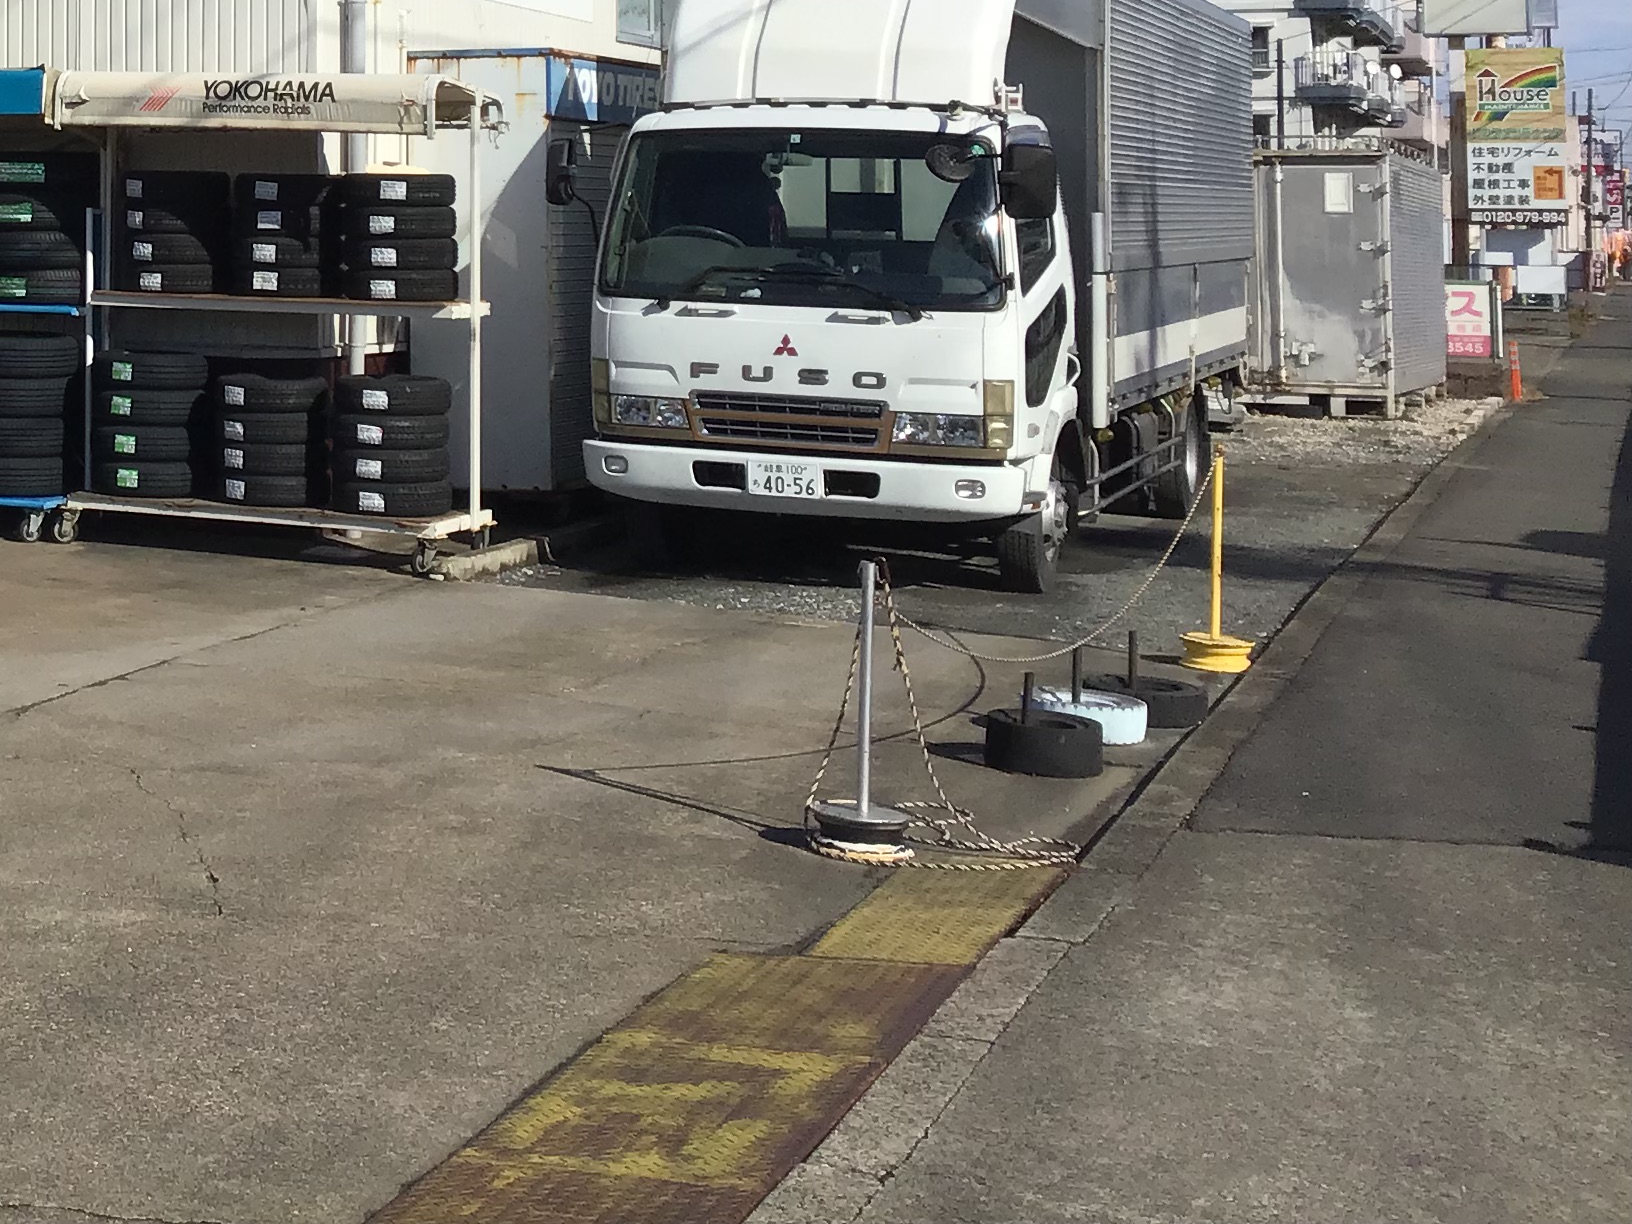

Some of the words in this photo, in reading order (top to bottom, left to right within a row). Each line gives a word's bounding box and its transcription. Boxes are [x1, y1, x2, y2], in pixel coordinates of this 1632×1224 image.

[204, 80, 337, 103] YOKOHAMA
[566, 67, 616, 106] TOYO
[1477, 73, 1549, 102] House
[202, 102, 270, 115] Performance
[272, 103, 311, 115] Radials
[1471, 146, 1560, 158] 住宅リフォーム
[1472, 162, 1515, 174] 不動産
[1472, 178, 1531, 190] 屋根工事
[1472, 194, 1531, 206] 外壁塗装
[689, 362, 887, 390] FUSO
[786, 465, 803, 475] 100
[763, 475, 816, 496] 40-56
